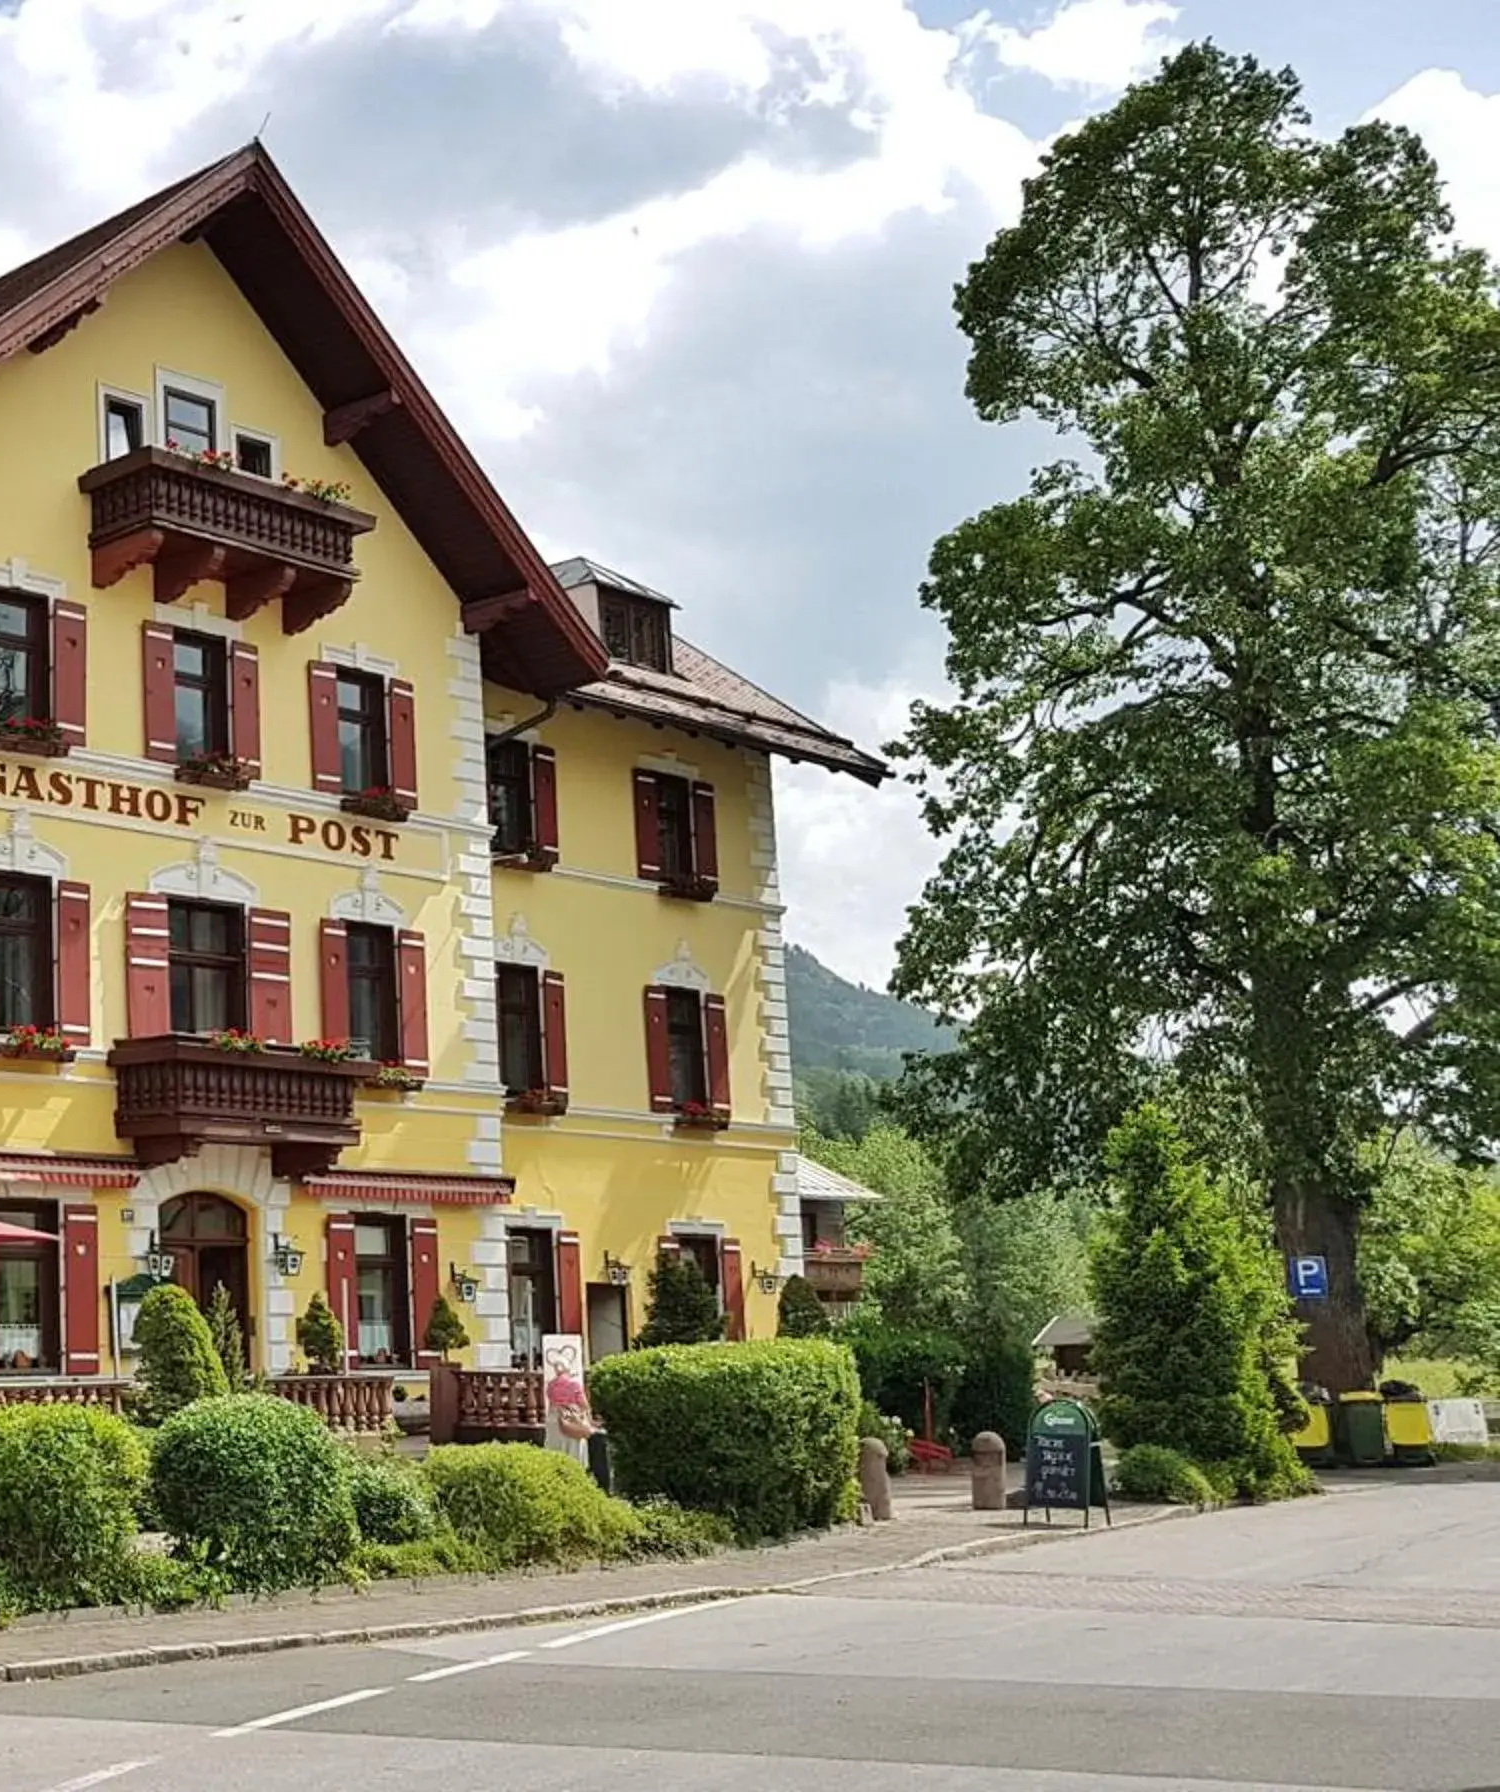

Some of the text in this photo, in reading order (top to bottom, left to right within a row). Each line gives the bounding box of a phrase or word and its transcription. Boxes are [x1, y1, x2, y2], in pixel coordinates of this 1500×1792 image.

[229, 809, 266, 832] ZUR
[287, 812, 400, 861] POST
[1297, 1259, 1319, 1286] P
